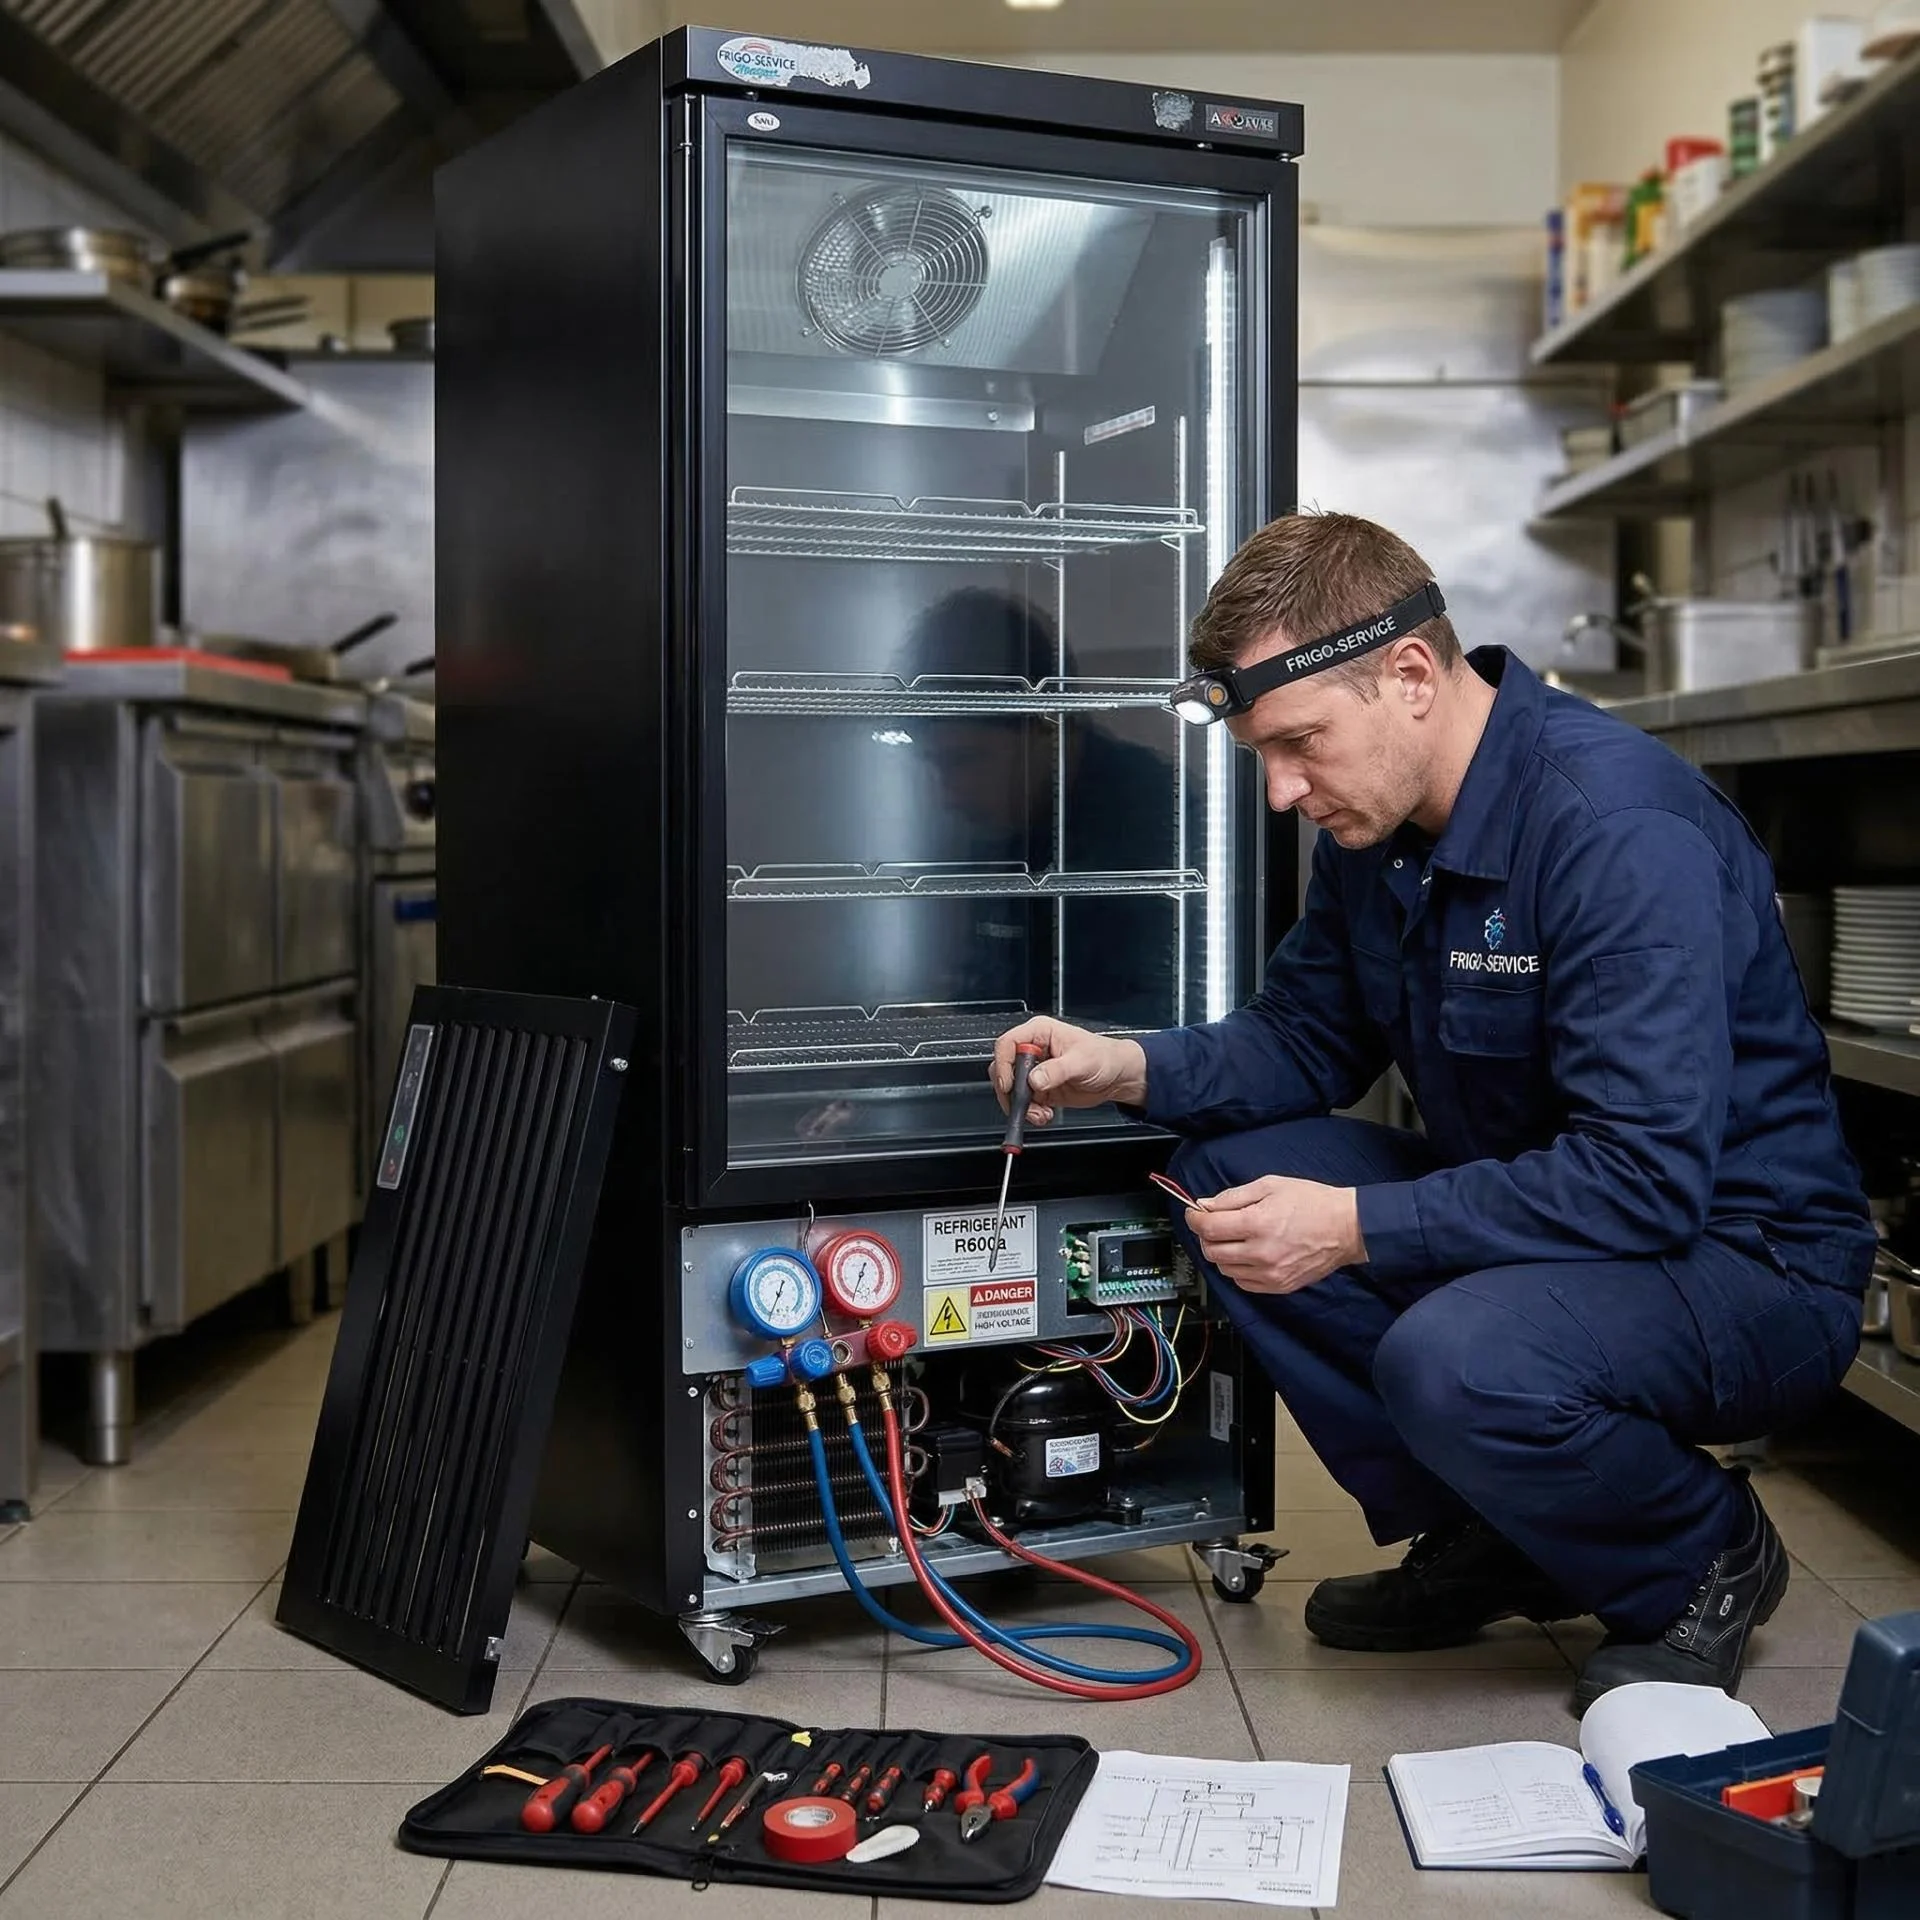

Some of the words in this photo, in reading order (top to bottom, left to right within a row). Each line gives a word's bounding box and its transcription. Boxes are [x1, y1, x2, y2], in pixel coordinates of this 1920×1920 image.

[719, 50, 796, 71] FRIGO-SERVICE
[1286, 616, 1397, 673] FRIGO-SERVICE
[1450, 950, 1541, 974] FRIGO-SERVICE
[984, 1286, 1033, 1302] DANGER
